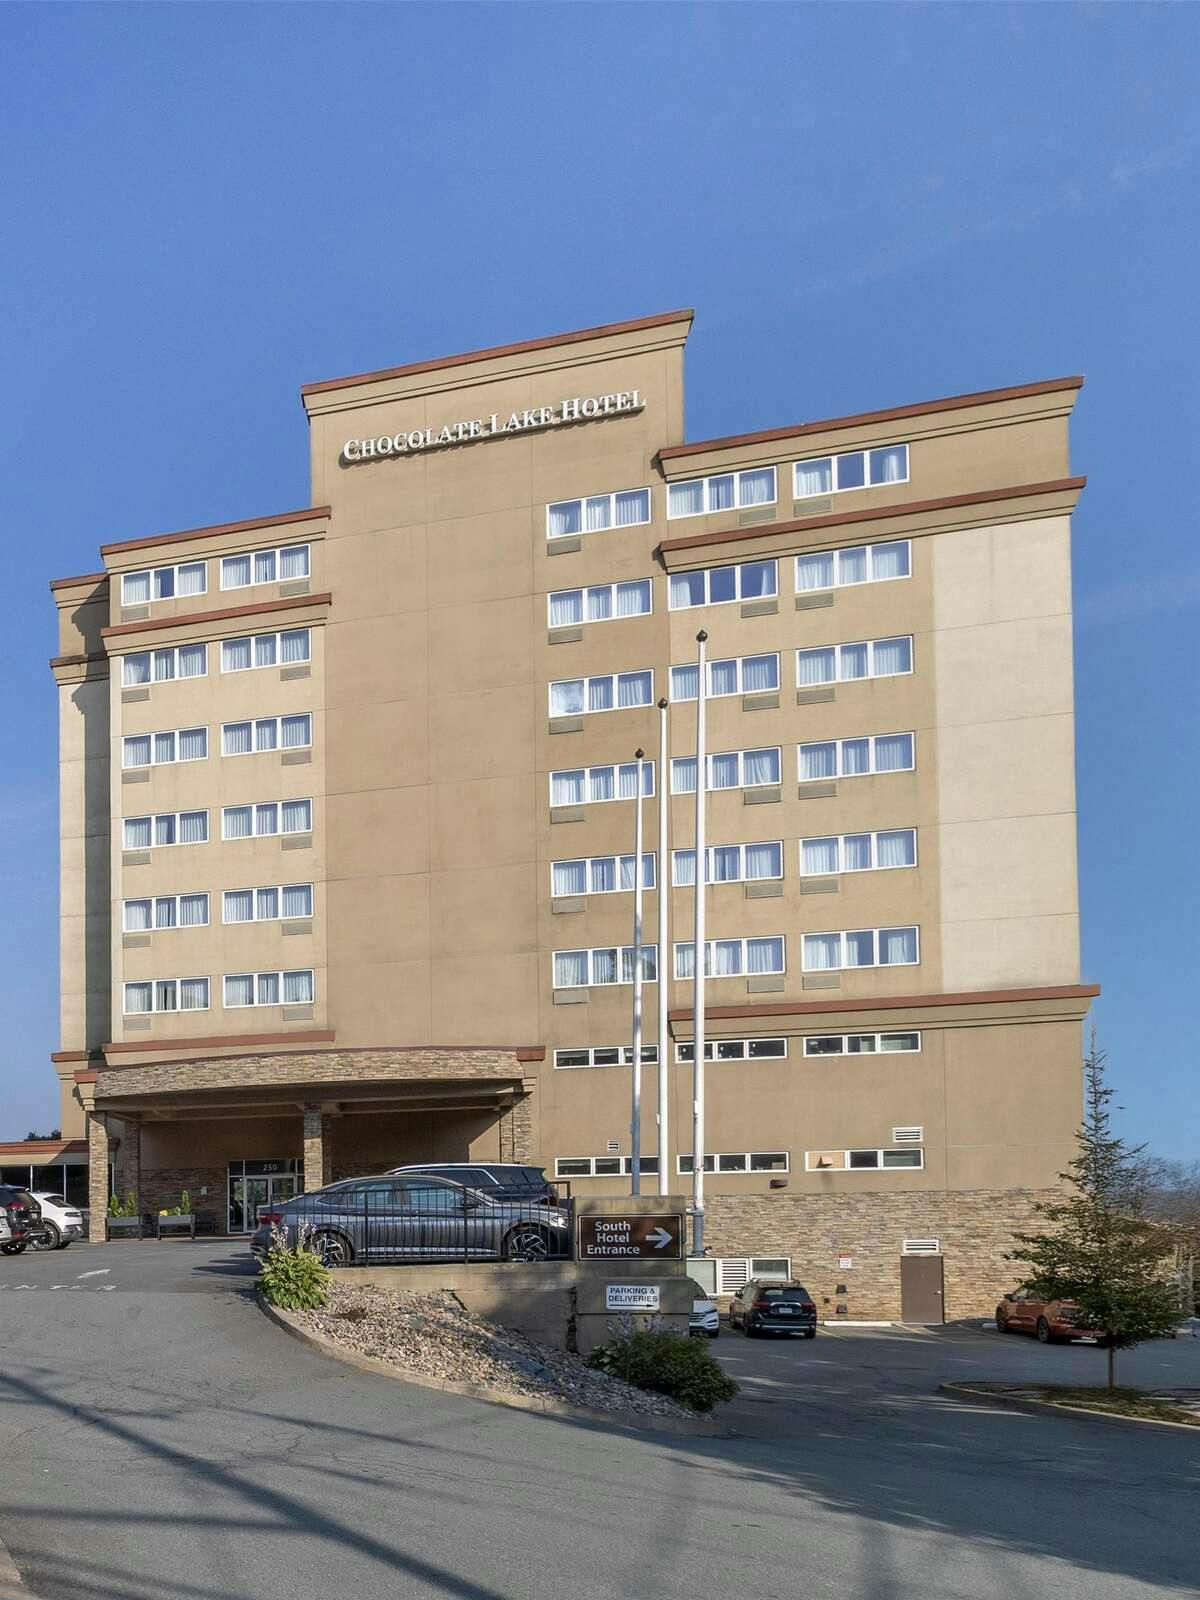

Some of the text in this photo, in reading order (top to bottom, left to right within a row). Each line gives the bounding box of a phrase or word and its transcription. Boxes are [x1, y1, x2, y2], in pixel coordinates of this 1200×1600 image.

[343, 389, 647, 461] CHOCOLATE LAKE HOTEL
[263, 1163, 278, 1171] 250
[594, 1221, 631, 1231] South
[596, 1232, 630, 1243] Hotel
[587, 1244, 640, 1254] Entrance
